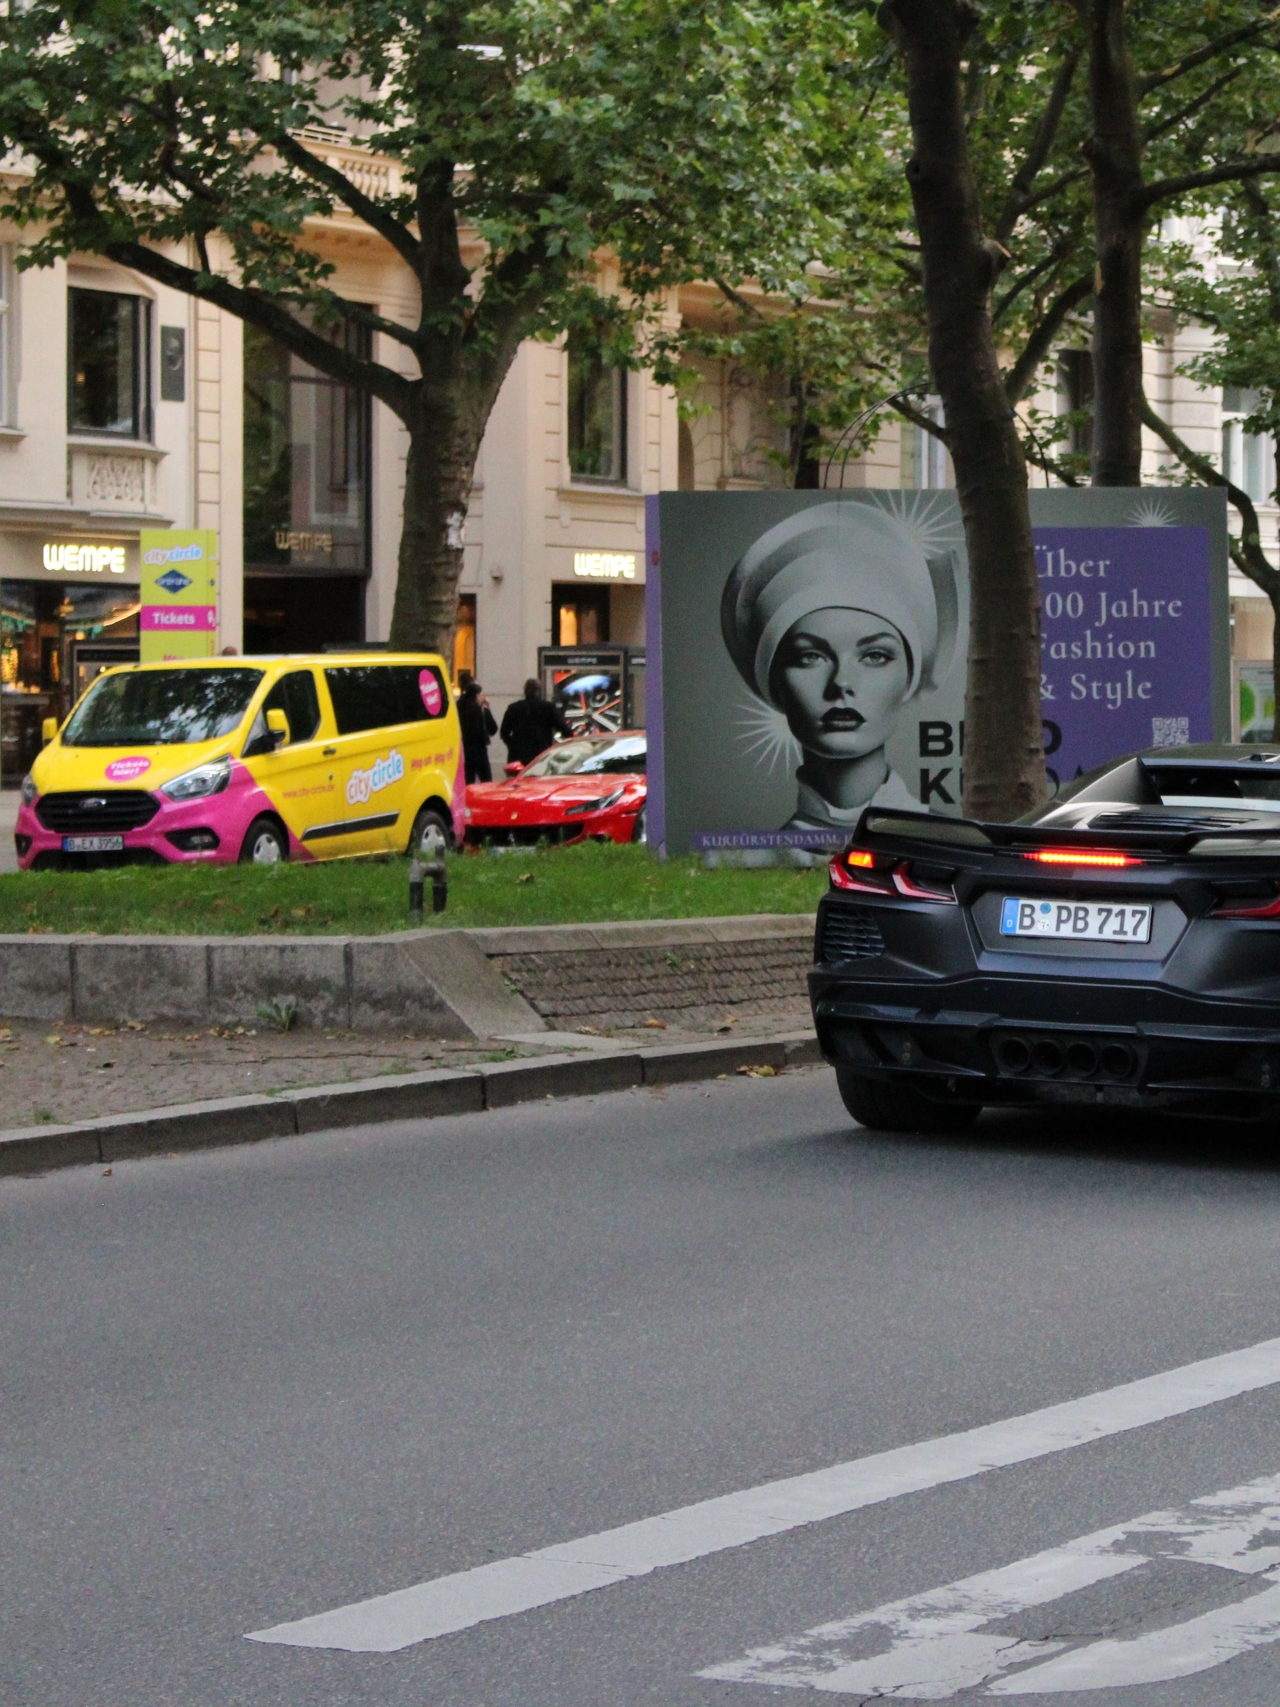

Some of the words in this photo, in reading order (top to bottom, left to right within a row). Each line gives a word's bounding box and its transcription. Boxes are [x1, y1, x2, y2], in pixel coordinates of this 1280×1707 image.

[275, 531, 332, 552] WEMPE
[43, 544, 126, 573] WEMPE
[574, 553, 635, 578] WEMPE
[153, 612, 195, 625] Tickets
[1095, 588, 1182, 627] Jahre
[1070, 670, 1152, 710] Style
[110, 759, 149, 771] Tickets
[1019, 903, 1036, 931] B
[1055, 905, 1089, 933] PB
[1097, 908, 1147, 936] 717
